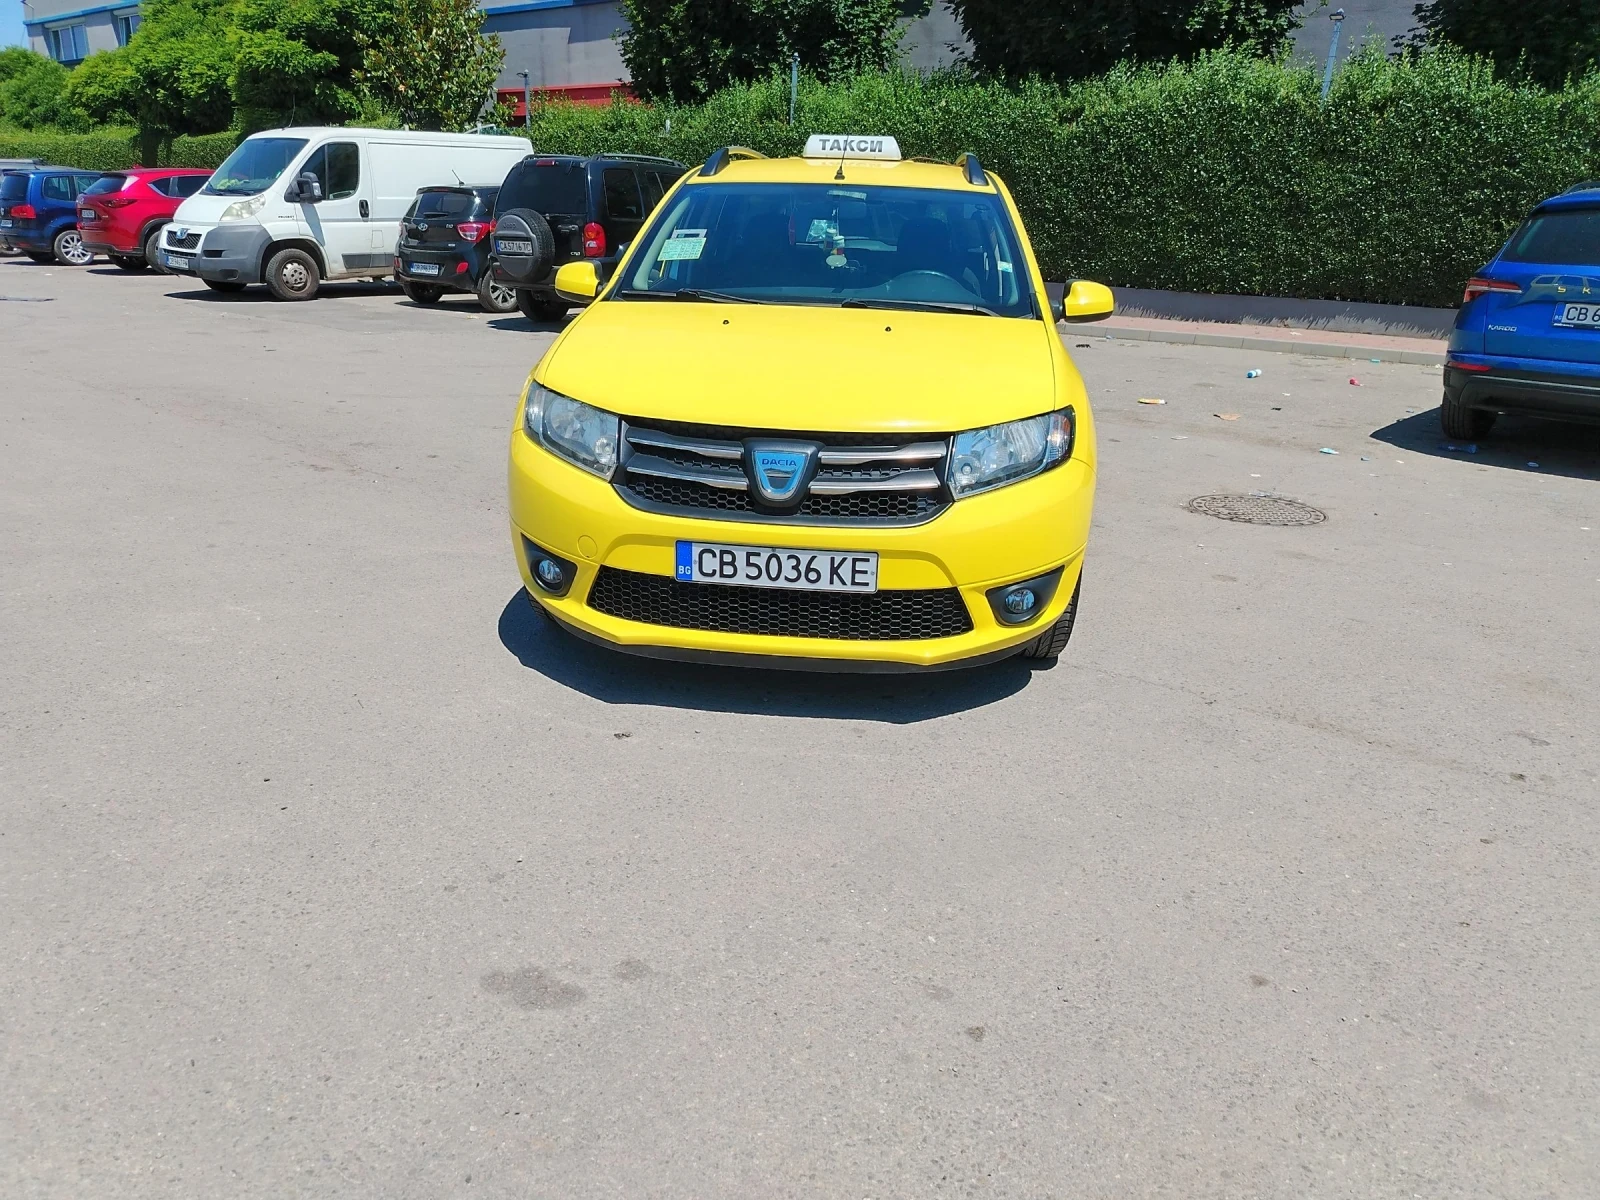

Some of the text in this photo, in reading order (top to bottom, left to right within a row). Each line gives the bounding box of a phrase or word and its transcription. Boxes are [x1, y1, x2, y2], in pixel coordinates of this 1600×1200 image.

[819, 138, 883, 153] ТАКСИ
[1566, 306, 1588, 322] CB
[762, 458, 796, 466] DACIA
[678, 565, 691, 575] BG
[698, 548, 870, 587] CB 5036 KE
